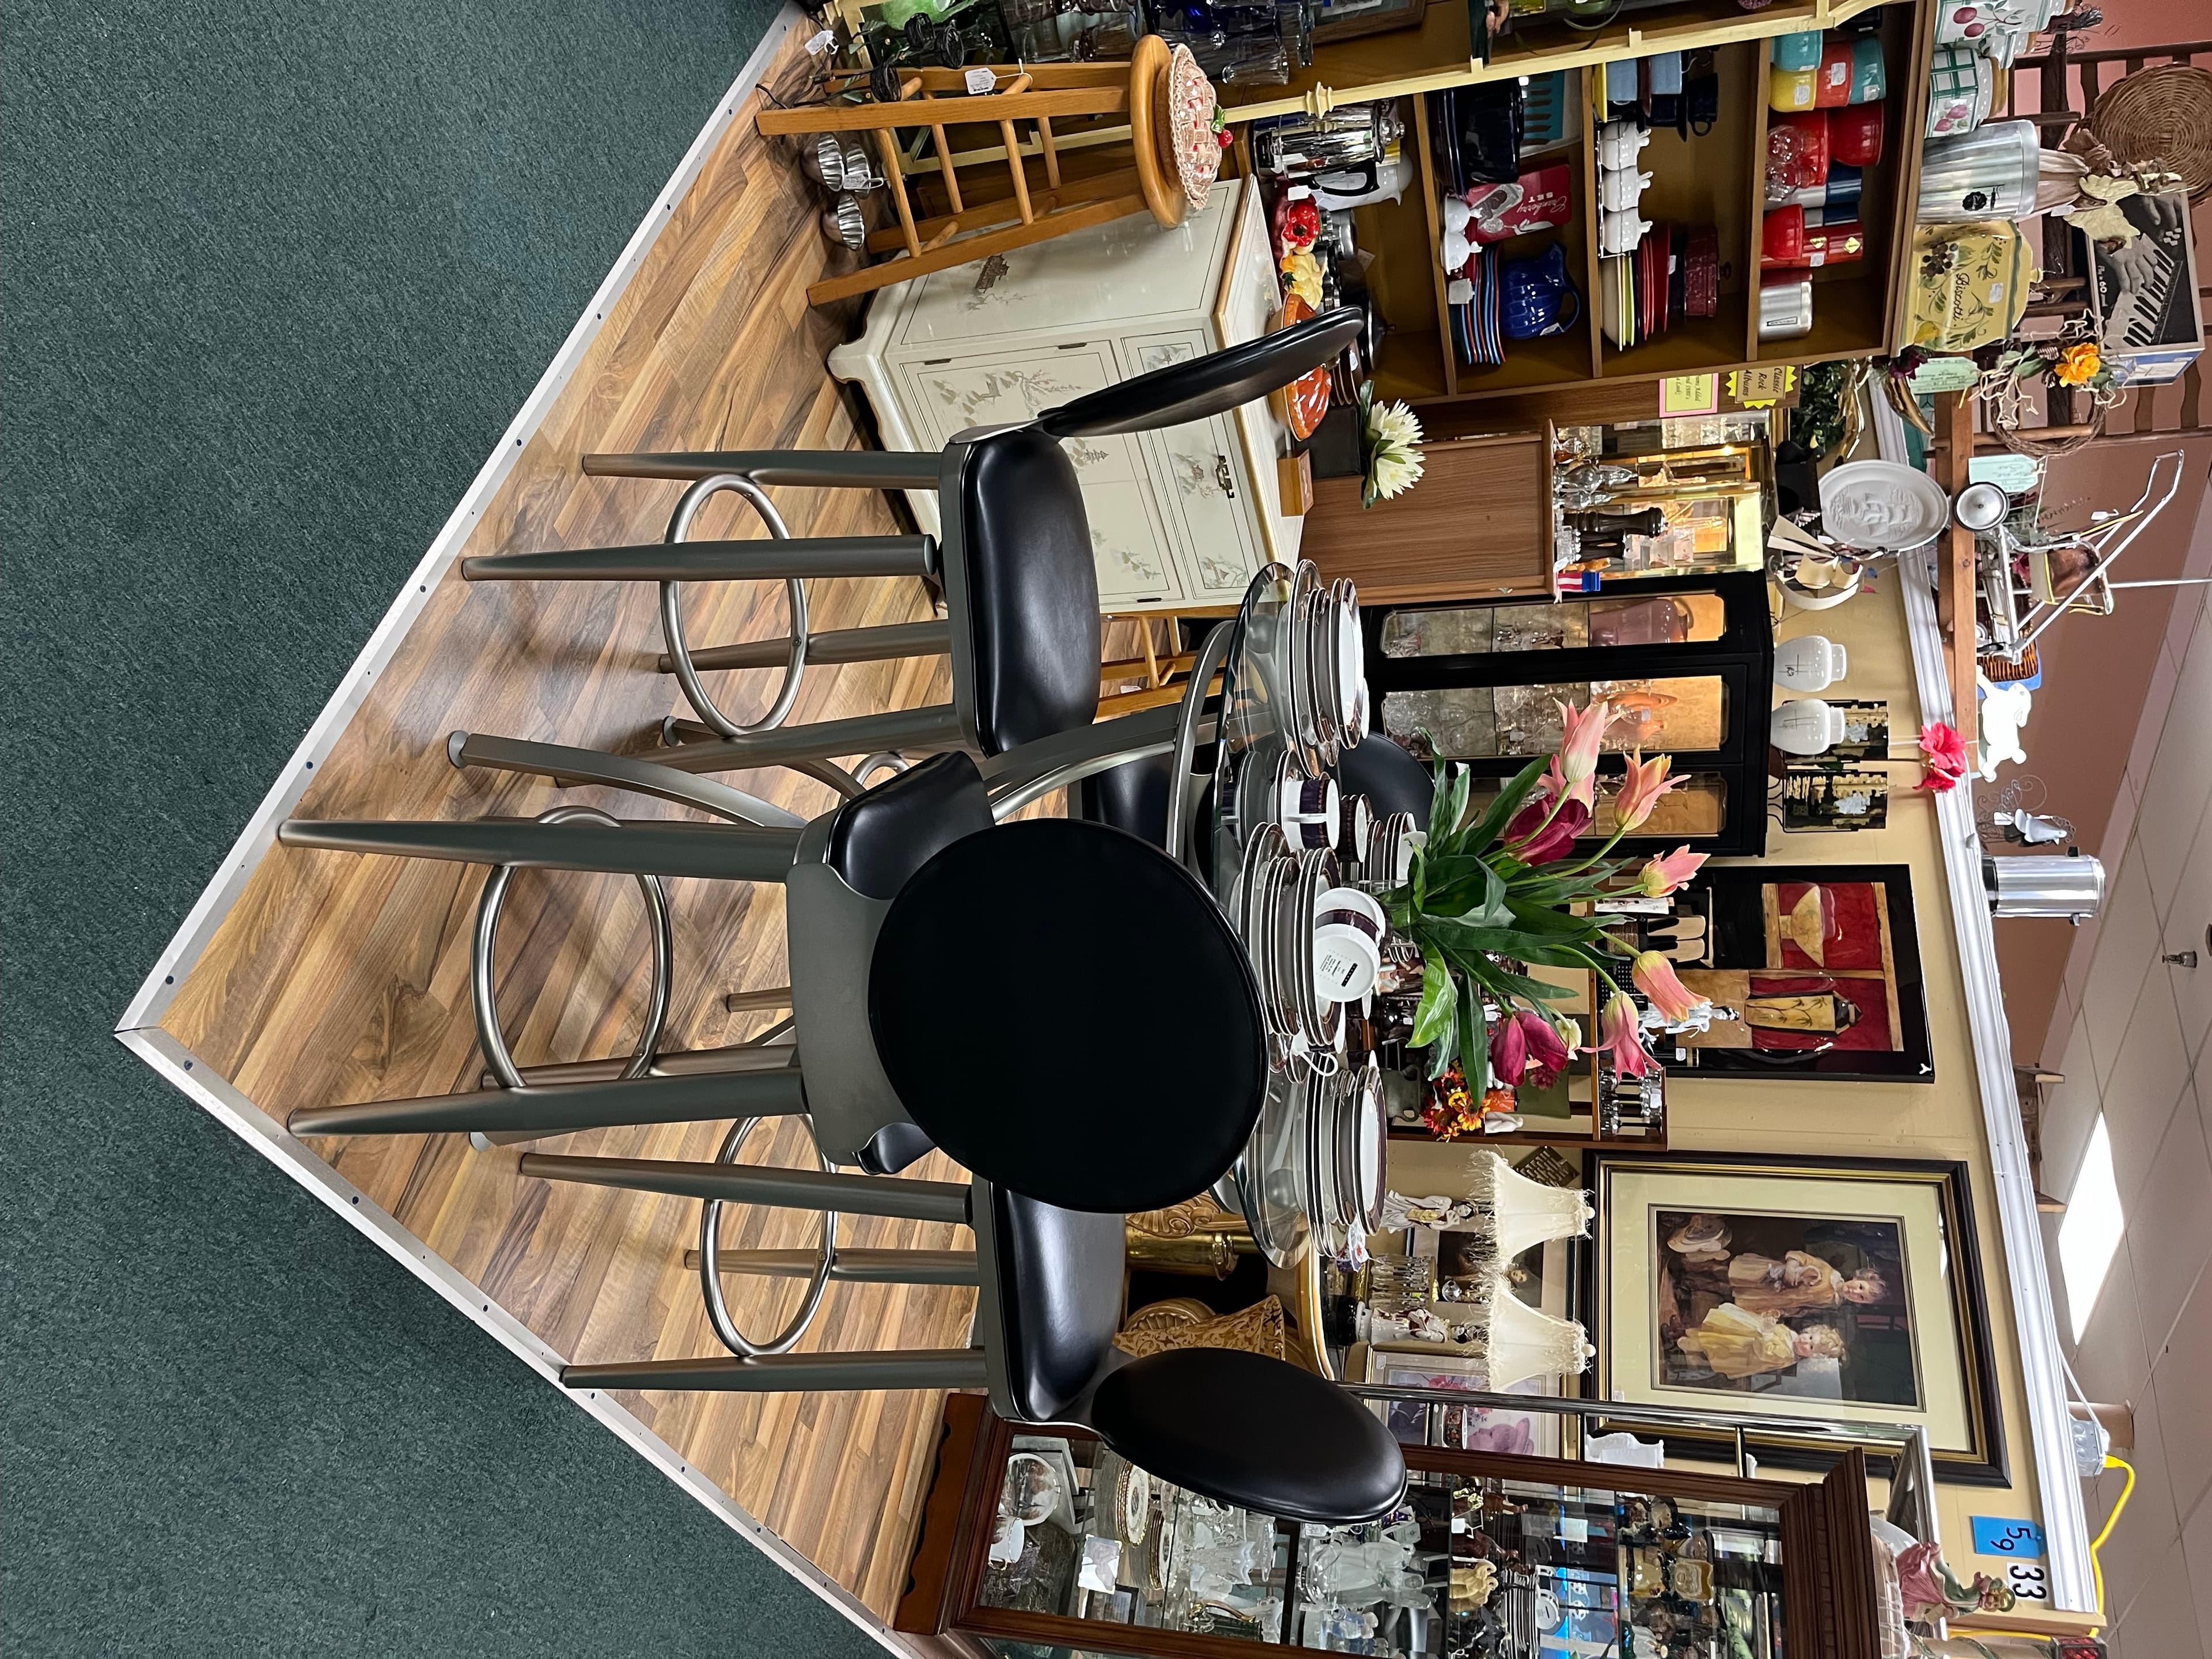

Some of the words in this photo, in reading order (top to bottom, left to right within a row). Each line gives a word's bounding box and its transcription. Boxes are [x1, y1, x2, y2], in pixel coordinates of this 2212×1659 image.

[1953, 272, 1970, 321] Biscotti
[2099, 281, 2108, 293] 60
[1742, 370, 1752, 396] Albums
[1758, 372, 1767, 390] Rock
[1772, 368, 1783, 393] Classic
[2009, 1565, 2047, 1600] 33
